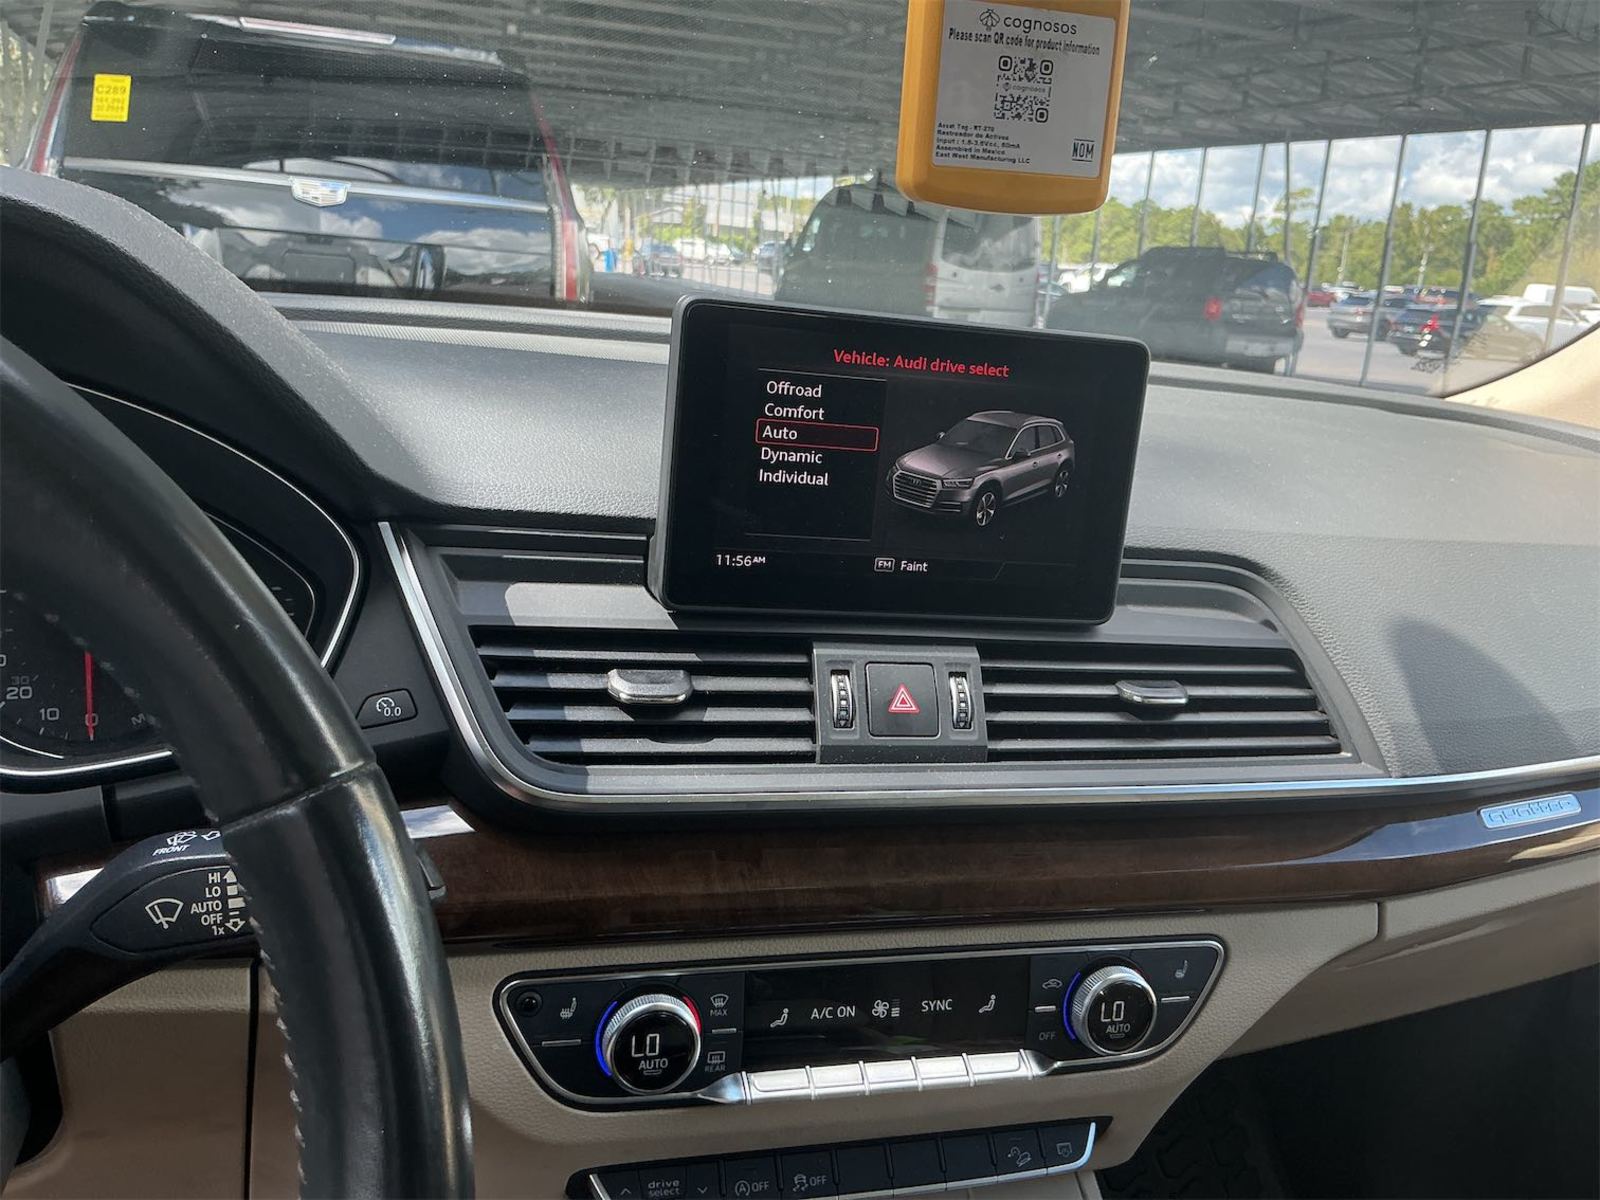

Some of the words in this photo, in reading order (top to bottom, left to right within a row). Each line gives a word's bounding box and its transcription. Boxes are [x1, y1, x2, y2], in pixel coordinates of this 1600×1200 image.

[1003, 16, 1077, 35] cognosos
[948, 27, 973, 42] Please
[974, 32, 992, 43] scan
[993, 32, 1004, 45] QR
[1005, 35, 1023, 47] code
[1024, 36, 1035, 48] for
[1035, 38, 1062, 51] product
[1063, 40, 1100, 55] information
[1072, 141, 1095, 160] NOM
[970, 154, 1016, 164] Manufacturing
[833, 348, 890, 368] Vehicle:
[893, 355, 927, 370] Audi
[930, 358, 966, 374] drive
[969, 361, 1010, 378] select
[766, 380, 822, 398] Offroad
[764, 402, 825, 420] Comfort
[762, 424, 798, 441] Auto
[760, 447, 823, 465] Dynamic
[758, 467, 829, 486] Individual
[900, 560, 928, 572] Faint
[6, 686, 33, 700] 20
[39, 707, 60, 721] 10
[1487, 799, 1571, 824] quattro
[152, 844, 191, 856] FRONT
[208, 872, 221, 884] HI
[205, 886, 221, 898] LO
[190, 900, 223, 914] AUTO
[201, 913, 223, 926] OFF
[211, 925, 225, 936] 1x
[709, 1007, 728, 1017] MAX
[811, 1006, 836, 1021] A/C
[837, 1004, 856, 1019] ON
[921, 998, 953, 1013] SYNC
[1100, 1000, 1125, 1022] LO
[1106, 1023, 1131, 1034] AUTO
[1038, 1031, 1056, 1041] OFF
[631, 1033, 660, 1058] LO
[638, 1057, 669, 1070] AUTO
[704, 1062, 726, 1073] REAR
[648, 1179, 680, 1189] drive
[751, 1180, 770, 1192] OFF
[809, 1175, 828, 1187] OFF
[649, 1186, 681, 1197] select
